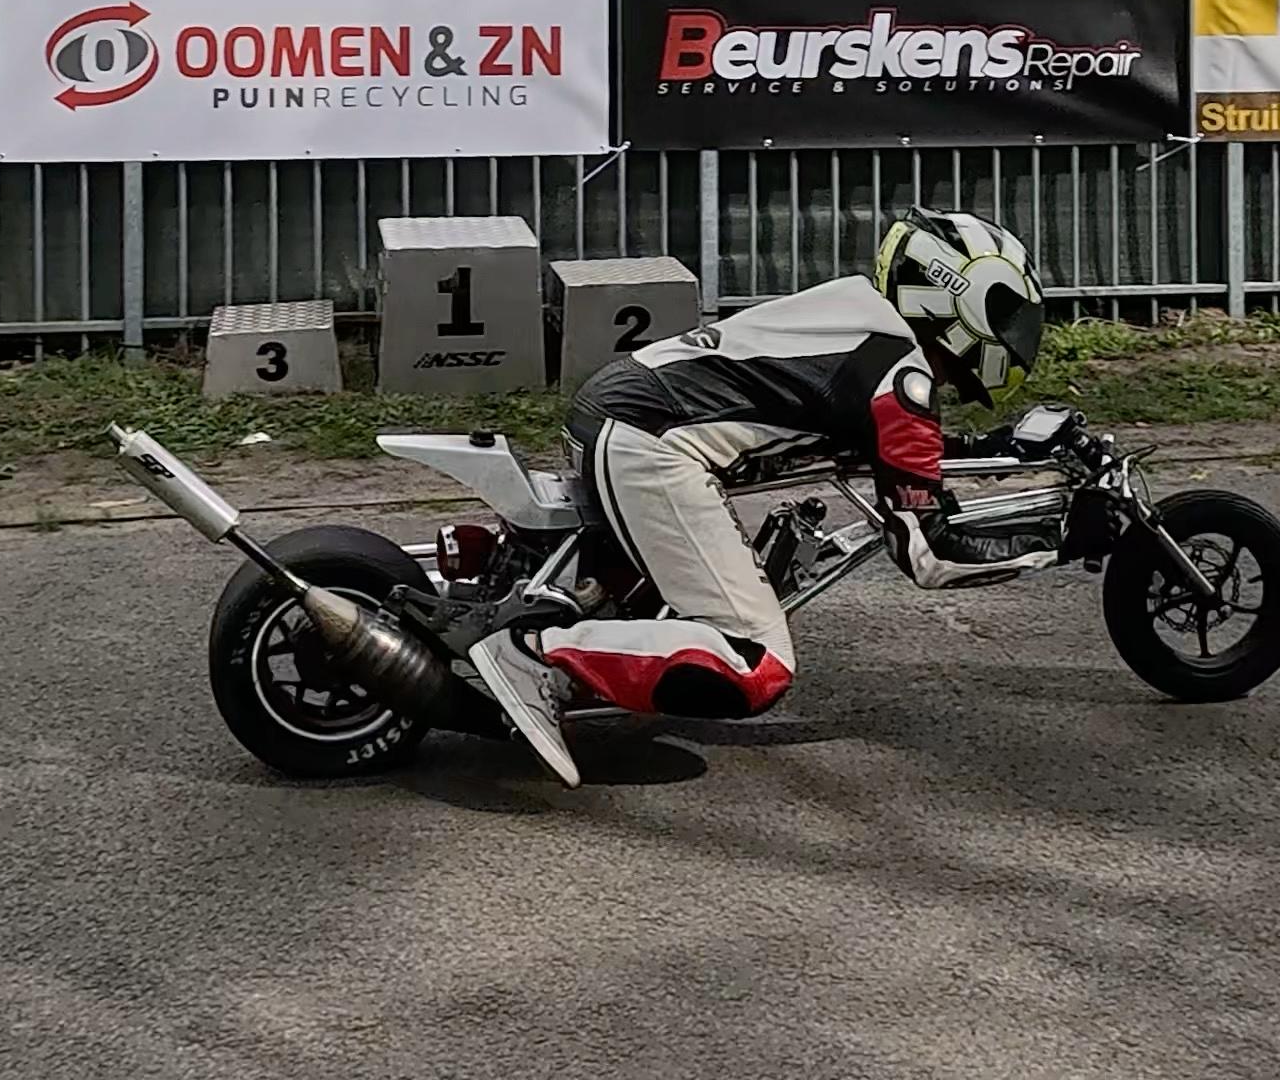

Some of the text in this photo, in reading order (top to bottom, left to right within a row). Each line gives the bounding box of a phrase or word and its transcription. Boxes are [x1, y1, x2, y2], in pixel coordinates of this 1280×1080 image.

[175, 25, 412, 79] OOMEN
[478, 25, 562, 76] ZN
[660, 12, 1141, 89] Beurskens Repair
[212, 84, 528, 109] PUINRECYCLING
[657, 79, 1065, 95] SERVICE & SOLUTIONS
[436, 266, 485, 337] 1
[612, 306, 653, 353] 2
[255, 341, 290, 383] 3
